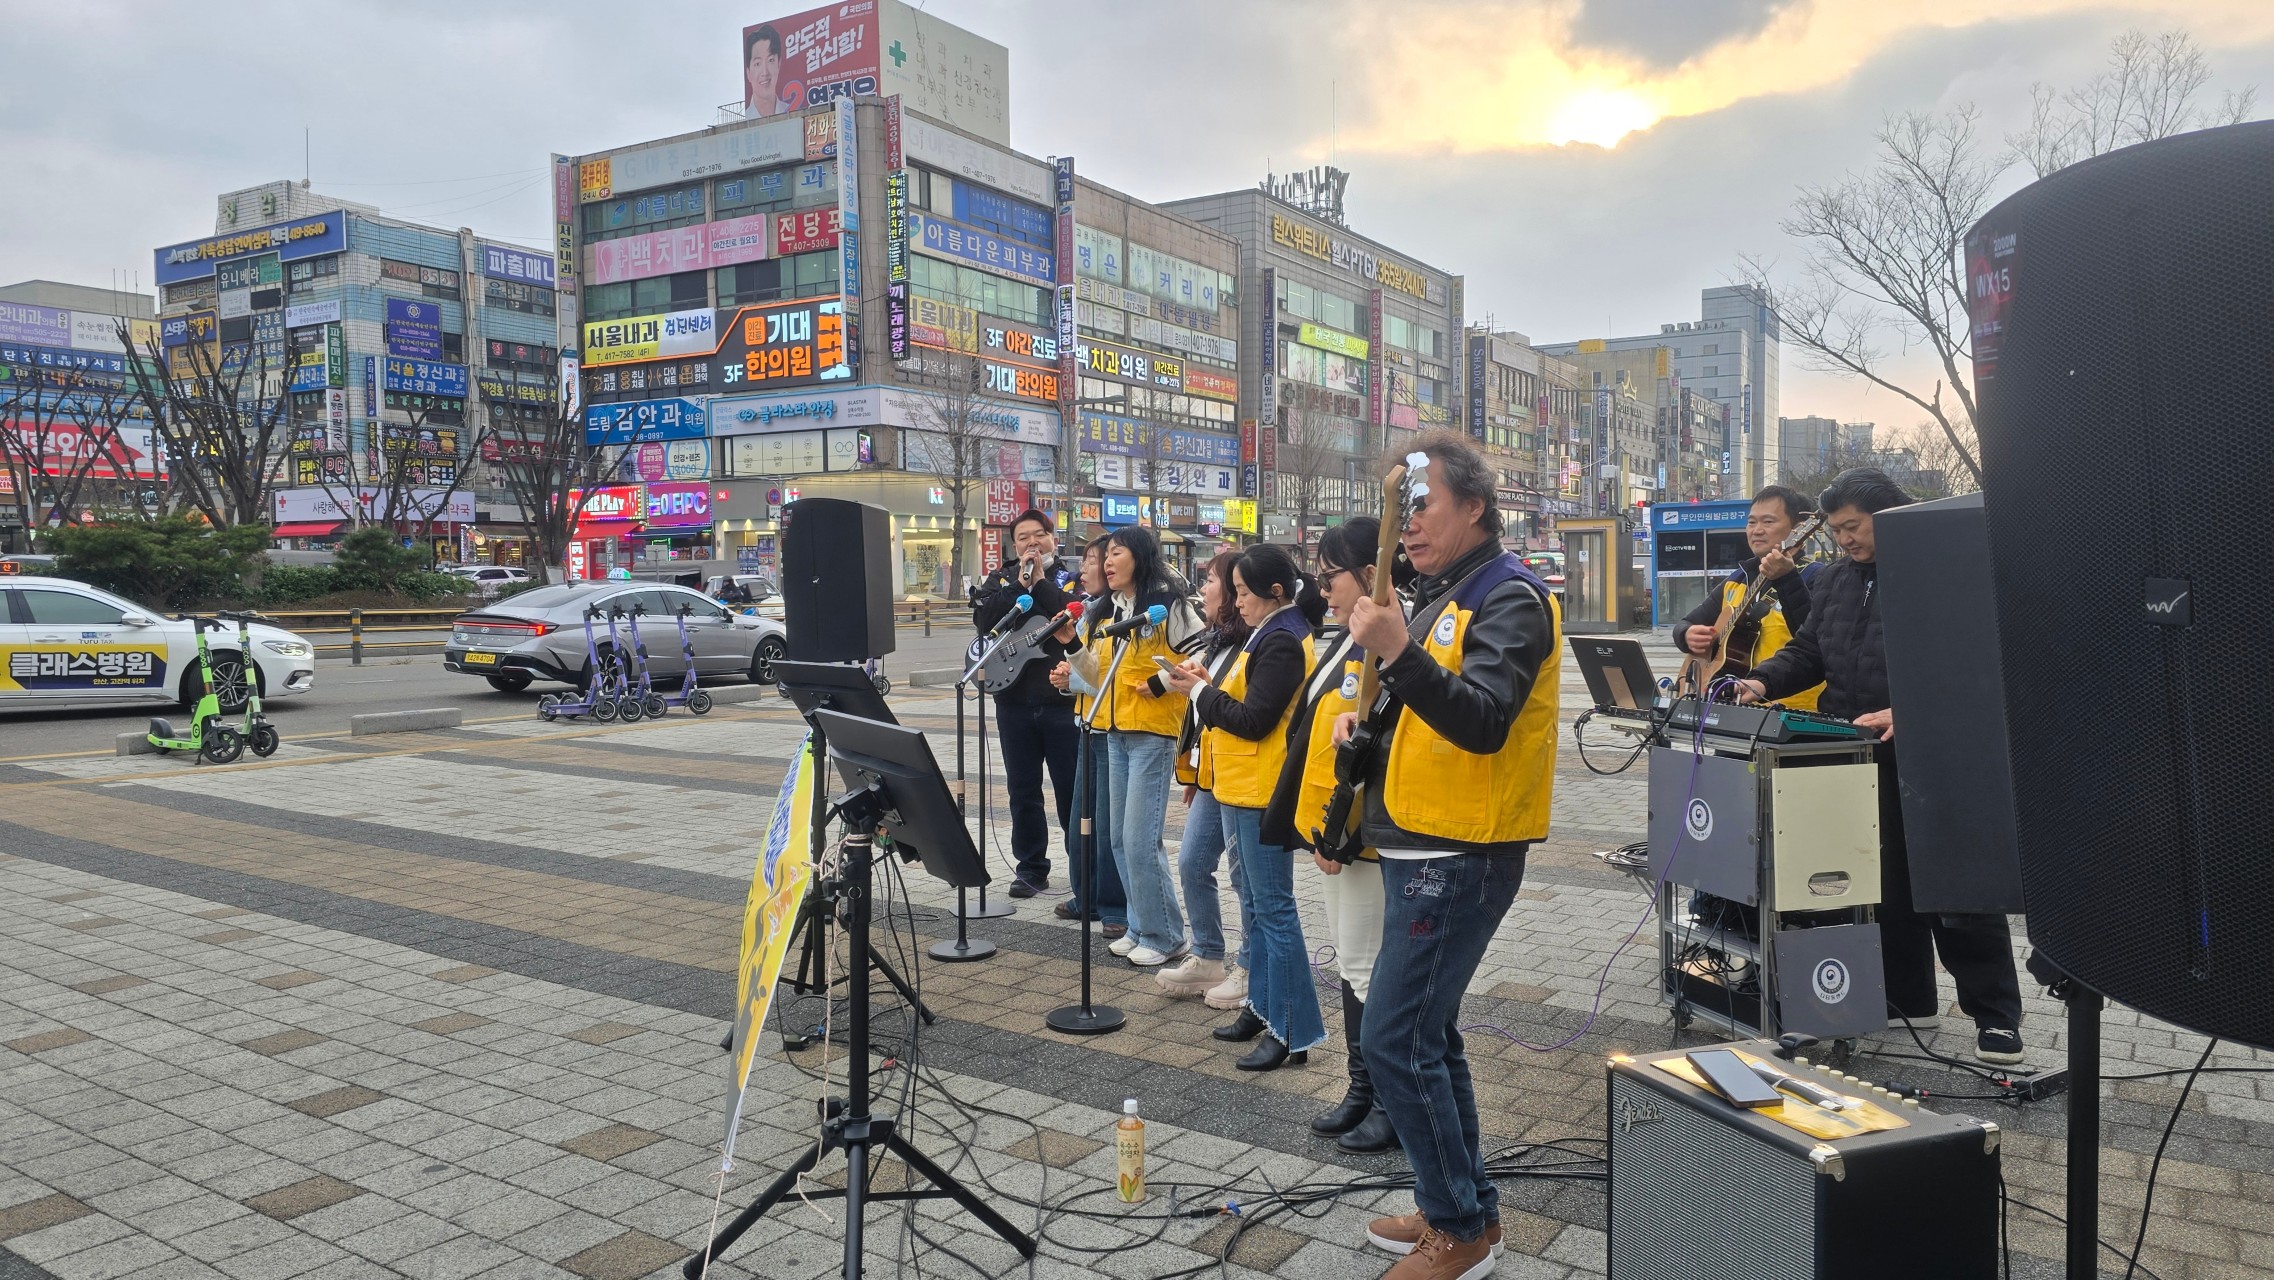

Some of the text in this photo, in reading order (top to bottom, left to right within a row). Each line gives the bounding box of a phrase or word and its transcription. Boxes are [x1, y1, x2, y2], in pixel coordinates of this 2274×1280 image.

[806, 24, 864, 74] 참신함!
[682, 163, 722, 178] 031-407-1976
[844, 114, 856, 207] 글라스타 안경
[581, 160, 610, 189] 컴퓨터방
[962, 165, 997, 185] 031-407-1976
[1058, 159, 1072, 192] 치과
[600, 188, 609, 198] 3F
[780, 210, 842, 243] 전당포
[559, 225, 573, 275] 서울내과
[631, 231, 705, 271] 백치과
[787, 238, 830, 252] T.407-5309
[927, 222, 1051, 278] 아름다운피부과
[220, 266, 260, 289] 유니베라
[1350, 248, 1365, 275] PT
[1364, 254, 1379, 281] GX
[1378, 259, 1402, 290] 365일
[1401, 269, 1427, 300] 24시간
[1975, 267, 2011, 298] WX15
[588, 315, 711, 348] 서울내과 검진센터
[747, 321, 763, 332] 야간
[747, 331, 763, 342] 진료
[767, 310, 811, 343] 기대
[890, 302, 905, 352] 노래광장
[329, 327, 342, 376] 파출매니저
[986, 327, 1058, 361] 3F 야간진료
[1192, 332, 1220, 357] 407-1976
[388, 360, 458, 382] 서울정신과
[663, 366, 677, 377] 다이
[694, 363, 708, 374] 맞춤
[724, 345, 812, 383] 3F 한의원
[1077, 342, 1180, 382] 백치과의원 야간진료
[1473, 348, 1484, 389] SHADOW
[401, 378, 438, 393] 신경과
[603, 373, 616, 383] 교통
[632, 369, 645, 380] 추나
[632, 379, 645, 389] 치료
[663, 375, 677, 386] 어트
[694, 373, 708, 383] 한약
[986, 364, 1058, 400] 기대한의원
[603, 382, 616, 392] 사고
[588, 416, 612, 432] 드림
[615, 402, 682, 431] 김안과
[684, 412, 704, 426] 의원
[757, 402, 807, 425] 글라스타
[808, 399, 835, 420] 안경
[325, 456, 345, 475] PC
[988, 480, 1016, 500] 대한
[601, 494, 626, 511] PLAY
[988, 501, 1020, 524] 부동산
[1184, 504, 1195, 517] CITY
[1680, 511, 1747, 522] 무인민원발급창구
[10, 651, 153, 678] 클래스병원
[131, 677, 146, 685] 위치
[1620, 1098, 1663, 1133] Fender
[1119, 1141, 1140, 1151] 옥수수
[1119, 1150, 1141, 1159] 수염차
